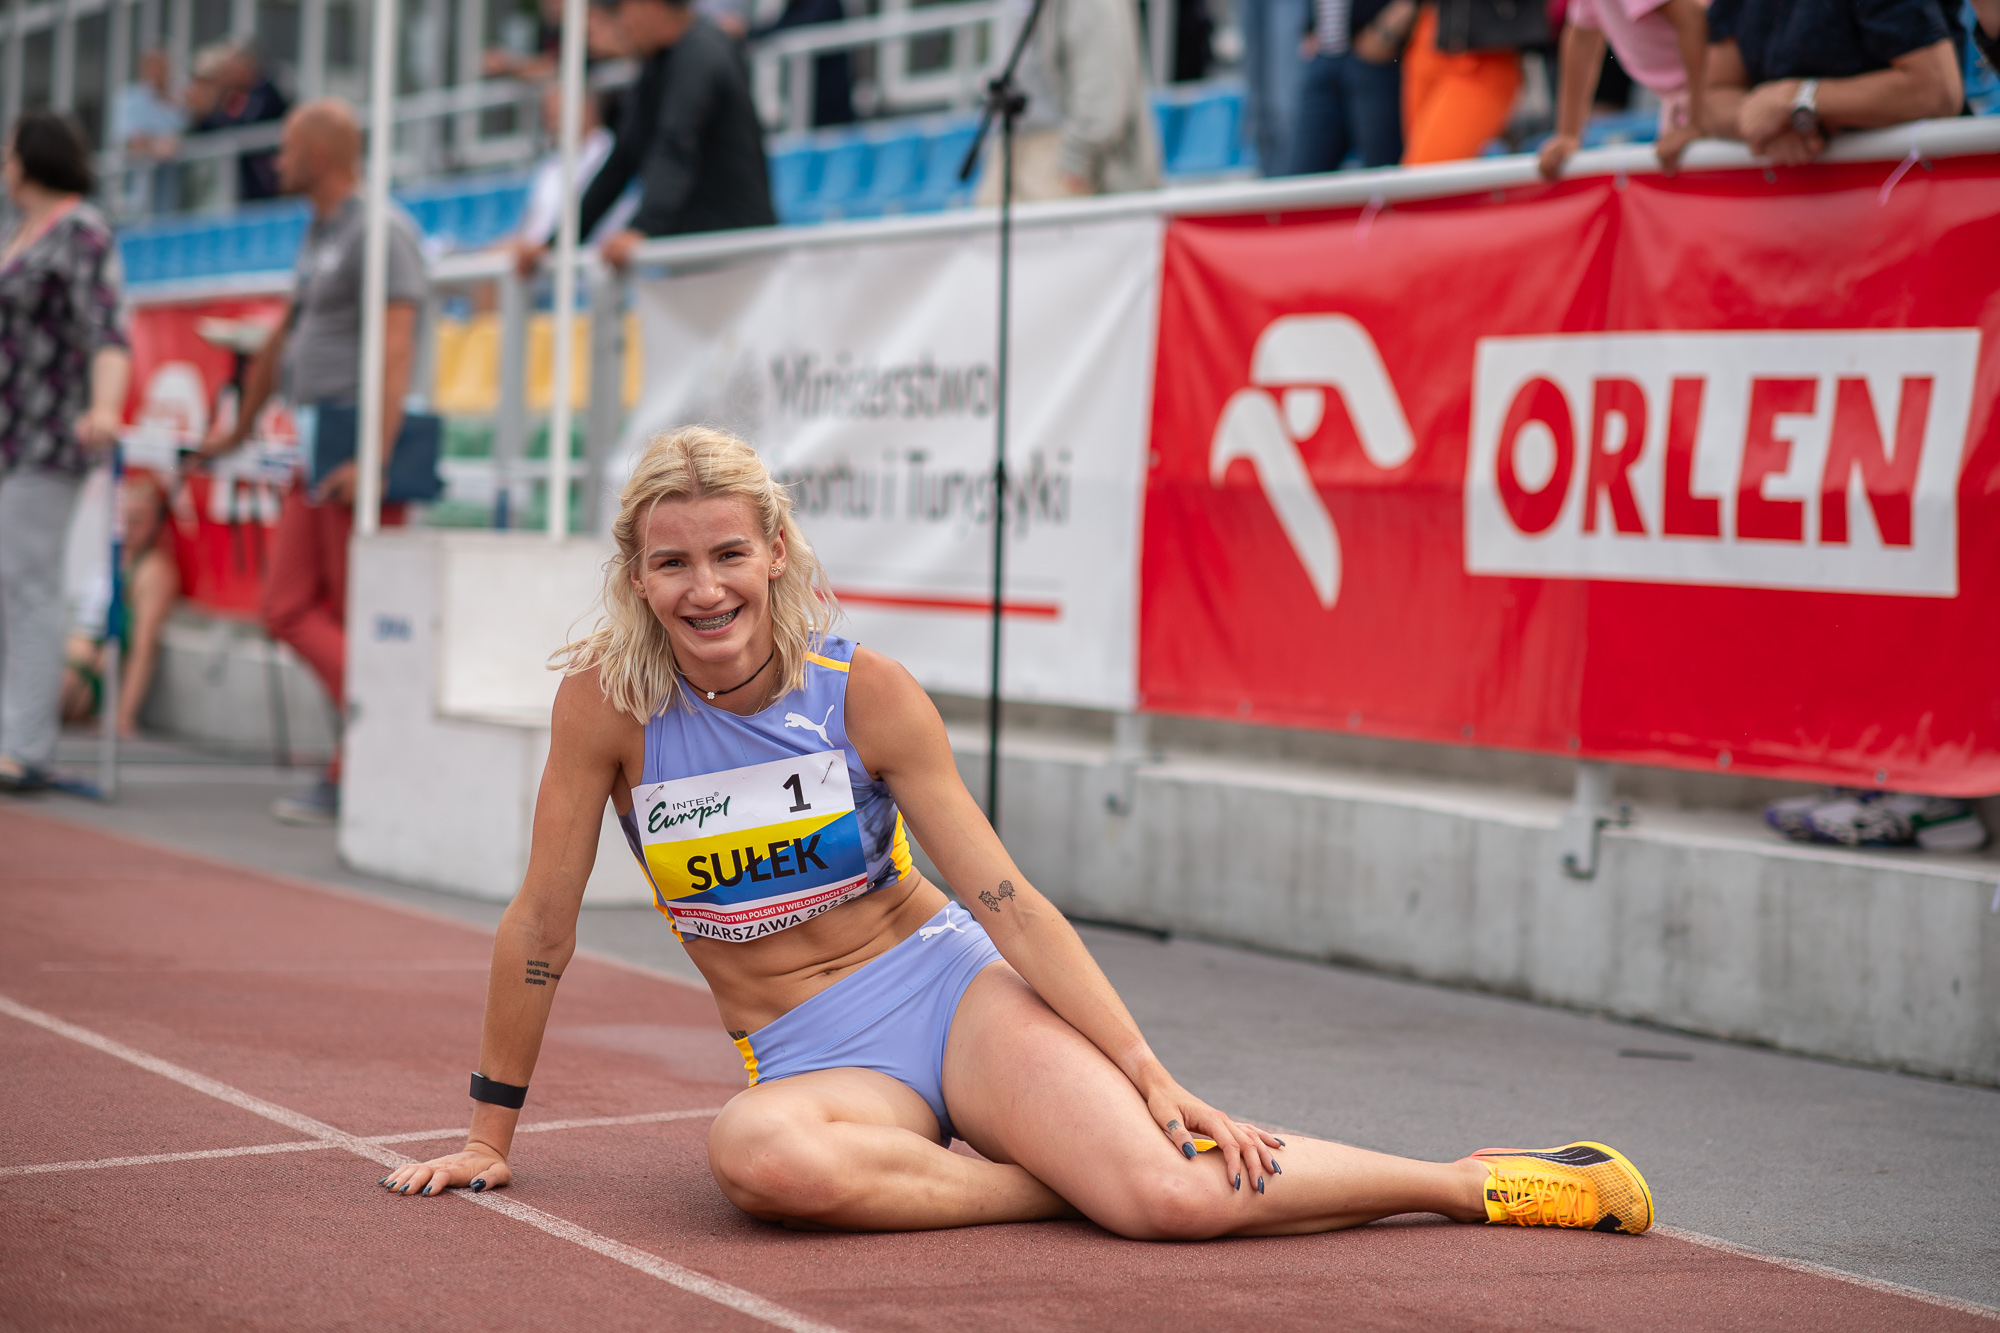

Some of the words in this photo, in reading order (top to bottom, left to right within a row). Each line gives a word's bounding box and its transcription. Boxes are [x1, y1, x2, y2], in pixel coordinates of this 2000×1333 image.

[1494, 372, 1936, 550] ORLEN
[903, 448, 1073, 540] Turysyki
[647, 795, 731, 834] Europol
[782, 773, 812, 813] 1
[686, 833, 829, 891] SUŁEK
[693, 914, 803, 941] WARSZAWA
[806, 894, 850, 919] 2023
[699, 910, 749, 923] MISTRZOSTWA
[748, 908, 776, 920] POLSKI
[776, 905, 785, 913] W
[785, 890, 840, 911] WIELOBOJACH
[840, 883, 858, 895] 2023
